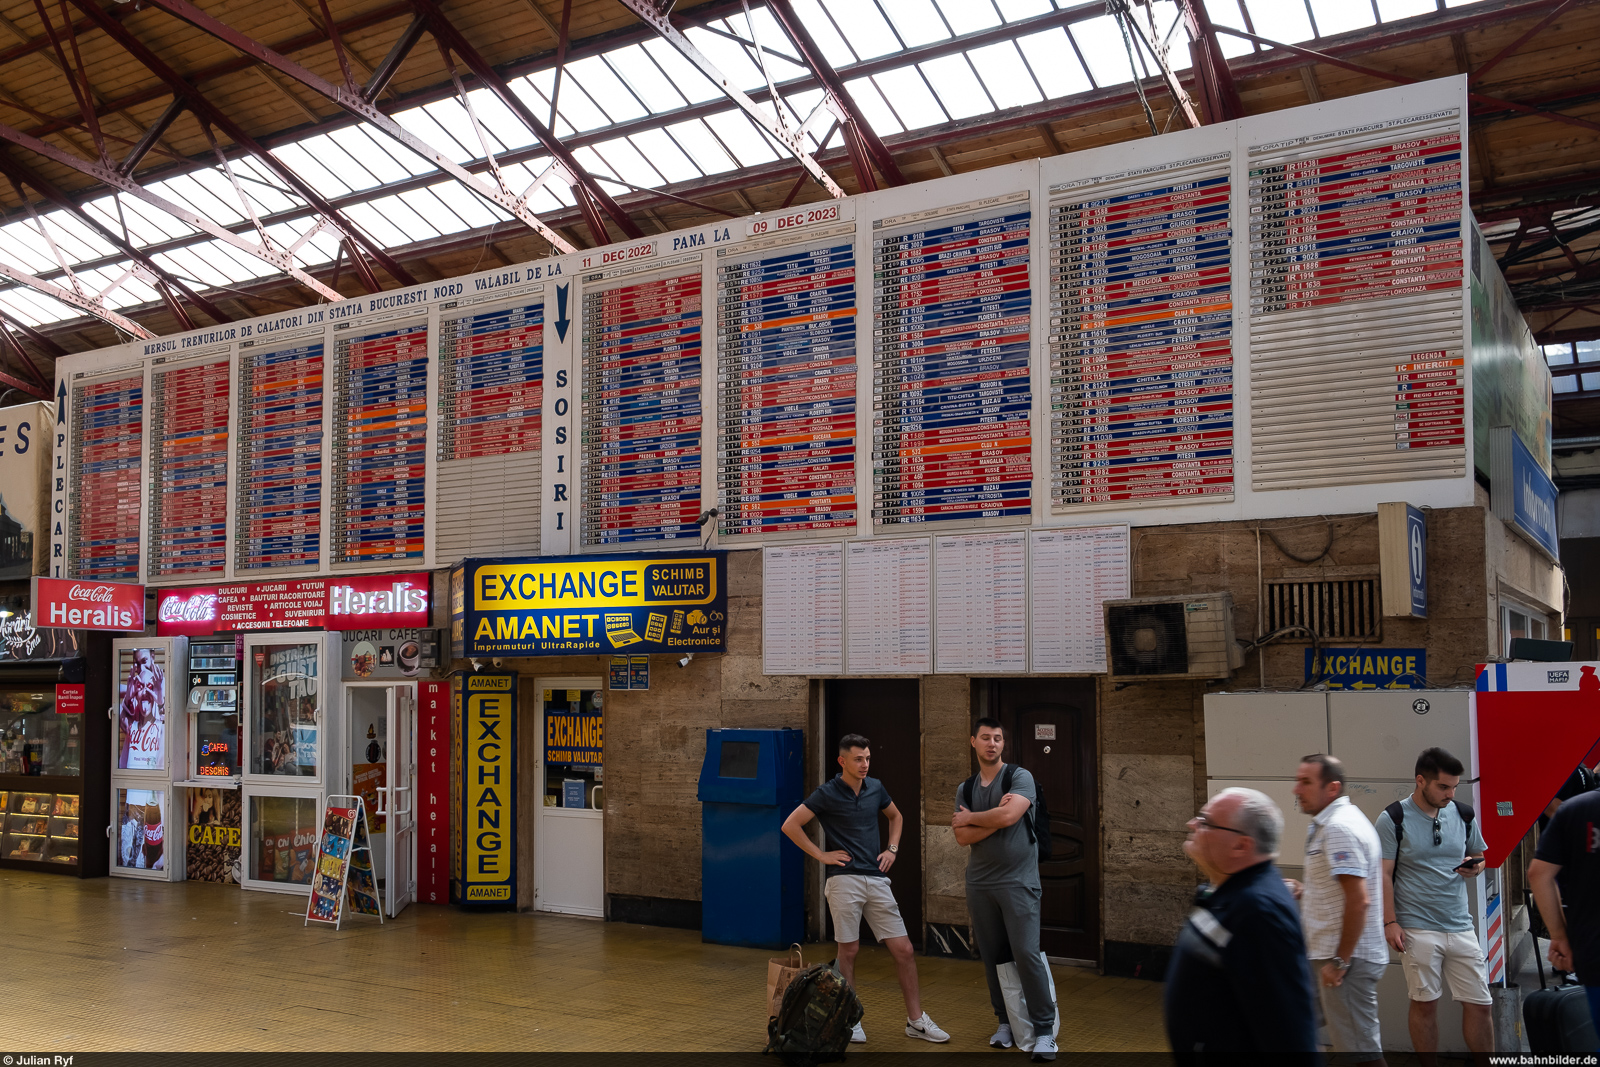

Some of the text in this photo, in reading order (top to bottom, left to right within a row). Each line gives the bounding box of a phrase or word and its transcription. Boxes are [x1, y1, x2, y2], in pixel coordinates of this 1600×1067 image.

[1262, 143, 1279, 151] ORA
[1280, 140, 1294, 148] TIP
[1355, 123, 1384, 134] PARCURS
[1287, 163, 1295, 171] IR
[1392, 140, 1421, 151] BRASOV
[1392, 178, 1425, 189] MANGALIA
[1395, 189, 1423, 198] BRASOV
[978, 217, 1005, 226] TARGOVISTE
[1391, 217, 1424, 228] CONSTANTA
[1302, 225, 1317, 233] 1664
[1286, 227, 1425, 254] RE 9918 CRAIOVA
[1302, 253, 1319, 261] 9028
[1395, 237, 1417, 246] PITESTI
[1395, 266, 1424, 275] BRASOV
[144, 206, 837, 355] MERSUL TRENURILOR DE CALATORI DIN STATIA BUCURESTI NORD VALABIL DE LA 11 DEC 2022 PANA LA 09 DEC 2023
[1172, 290, 1198, 298] CRAIOVA
[1302, 300, 1312, 308] 73
[1390, 285, 1427, 296] LOKOSHAZA
[911, 306, 926, 314] 11032
[980, 294, 1002, 303] BRASOV
[1174, 309, 1188, 317] CLUJ
[1412, 351, 1443, 361] LEGENDA
[1092, 364, 1107, 372] 1734
[1398, 360, 1453, 372] IC INTERCITY
[1417, 370, 1453, 379] INTERREGIO
[1092, 433, 1113, 442] 11038
[1176, 425, 1199, 433] BRASOV
[554, 369, 569, 530] SOSIRI
[53, 433, 66, 578] PLECARI
[652, 568, 704, 581] SCHIMB
[218, 582, 325, 595] DULCIURI JUCARII TUTUN
[481, 570, 638, 601] EXCHANGE
[652, 584, 705, 597] VALUTAR
[69, 584, 115, 603] Coca-Cola
[218, 590, 325, 603] CAFEA BAUTURI RACORITOARE
[330, 581, 427, 615] Heralis
[227, 600, 323, 612] REVISTE ARTICOLE VOIAJ
[50, 602, 132, 627] Heralis
[221, 609, 325, 620] COSMETICE SUVENIRURI
[236, 619, 309, 630] ACCESORII TELEFOANE
[474, 614, 600, 641] AMANET
[692, 625, 711, 634] Aur
[388, 629, 420, 641] CAFE
[667, 636, 721, 646] Electronice
[541, 640, 600, 650] UltraRapide
[276, 659, 317, 684] GUST
[470, 678, 509, 688] AMANET
[428, 683, 438, 773] market
[547, 715, 603, 748] EXCHANGE
[208, 742, 229, 753] CAFEA
[547, 750, 603, 764] SCHIMB VALUTAR
[476, 699, 502, 874] EXCHANGE
[189, 824, 241, 847] CAFE
[294, 833, 316, 848] Chio
[469, 888, 508, 898] AMANET
